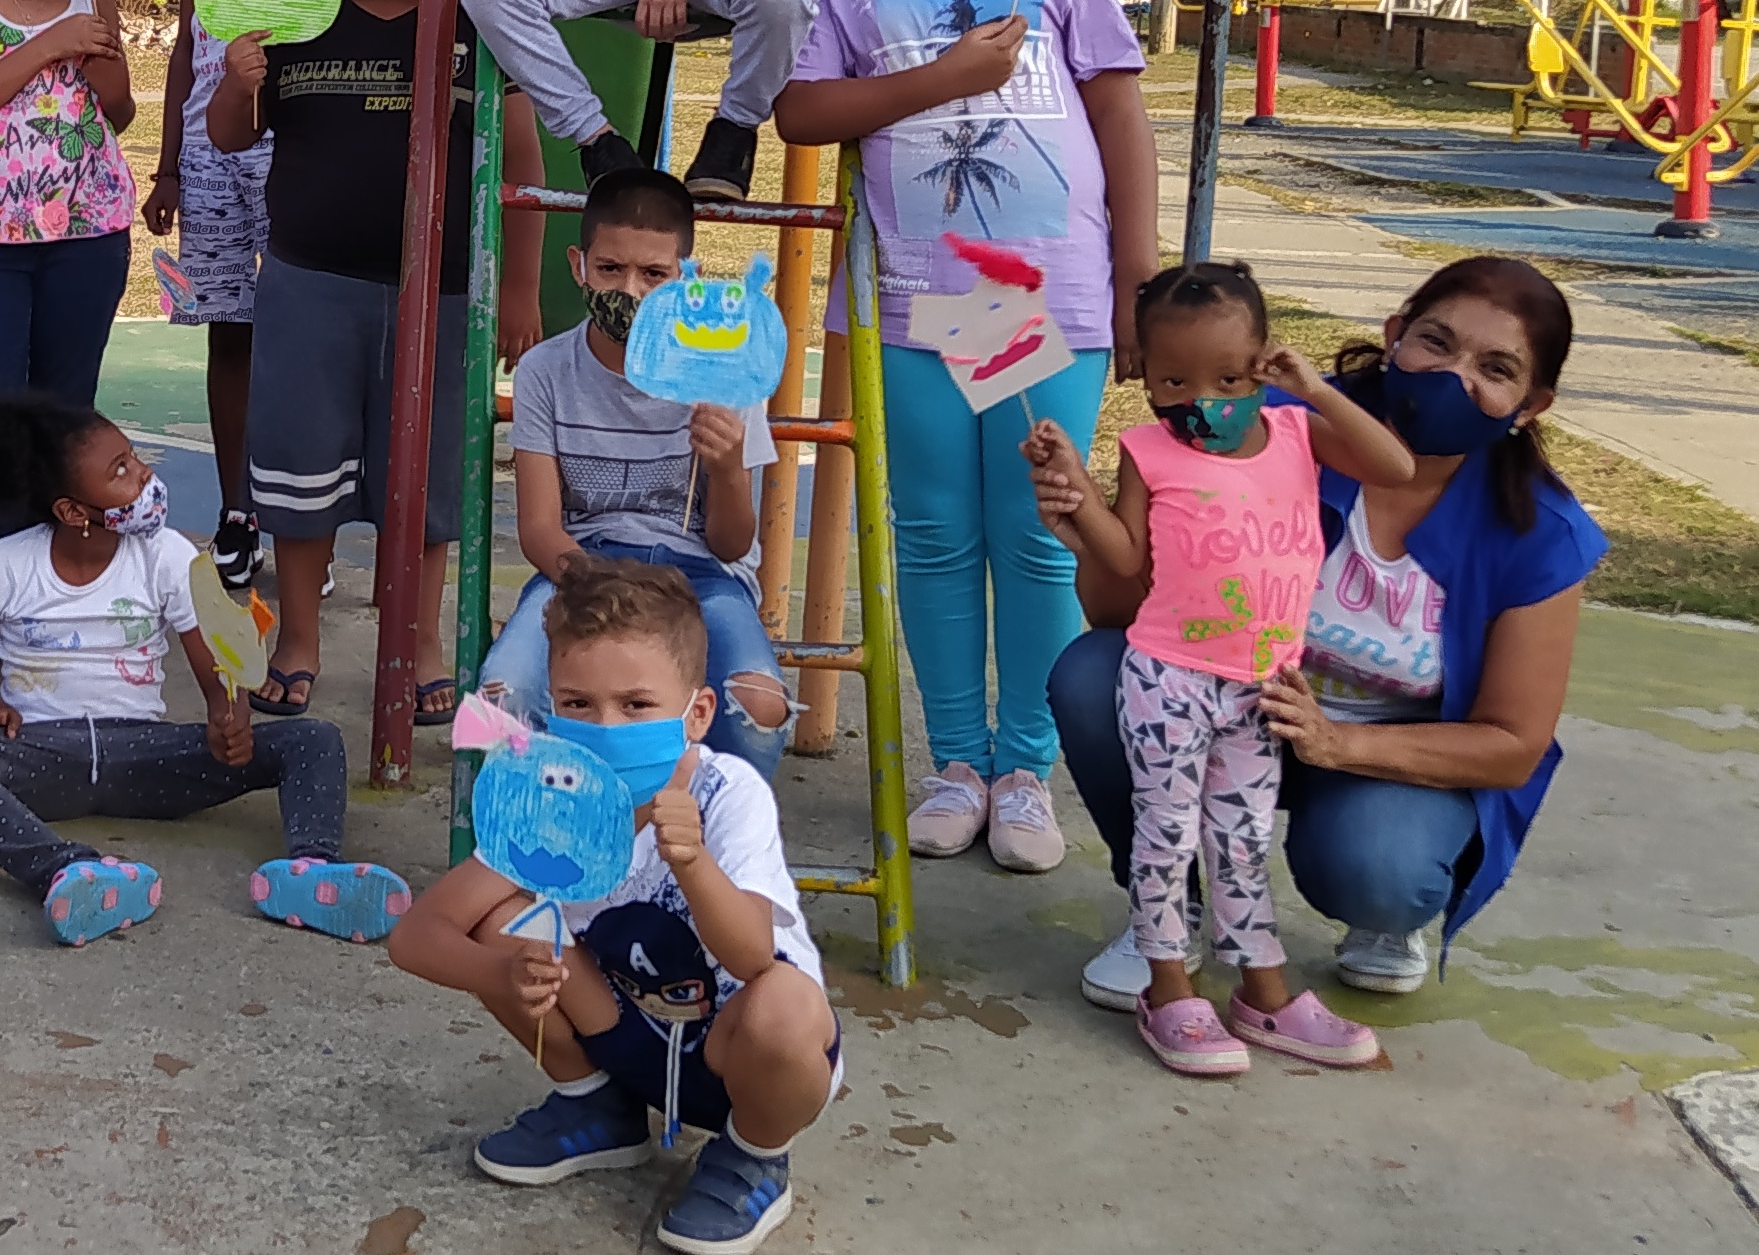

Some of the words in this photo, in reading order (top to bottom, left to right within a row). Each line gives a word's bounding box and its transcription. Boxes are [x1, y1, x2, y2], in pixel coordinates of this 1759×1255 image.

[276, 59, 403, 86] ENDURANCE
[878, 273, 931, 291] riginals
[1316, 550, 1445, 634] OVE
